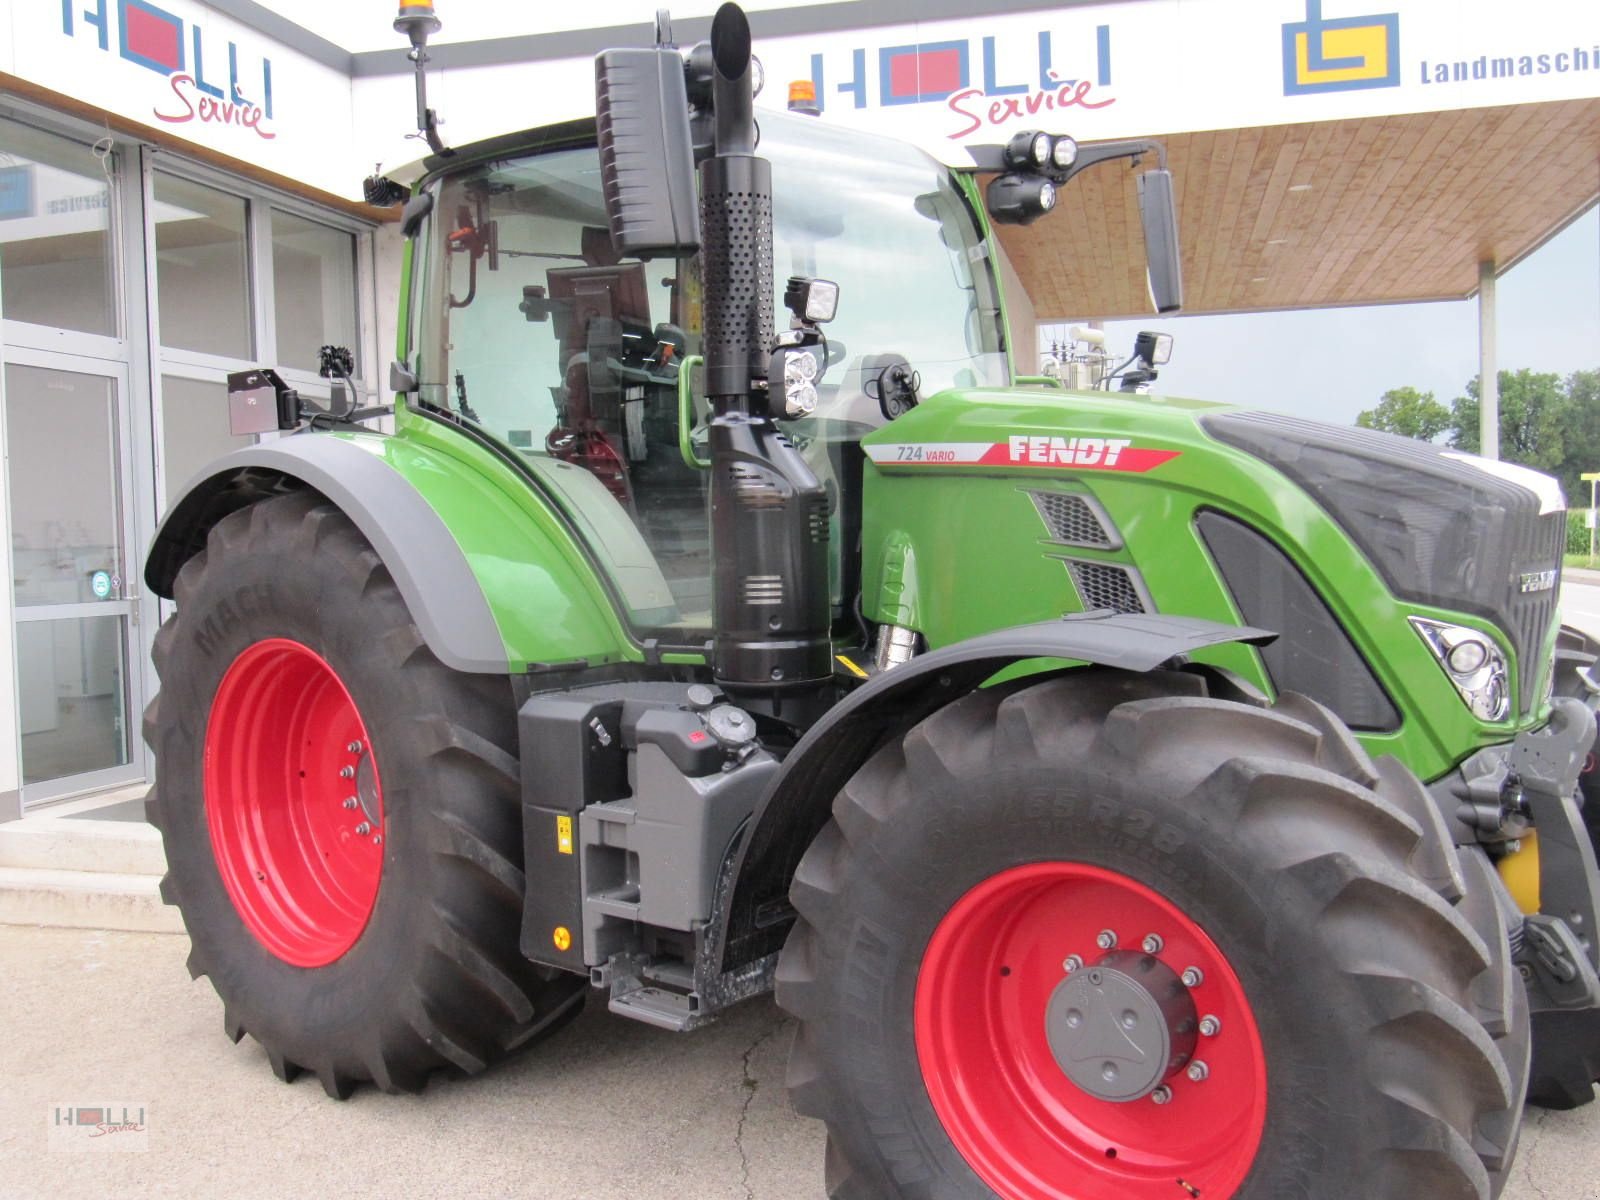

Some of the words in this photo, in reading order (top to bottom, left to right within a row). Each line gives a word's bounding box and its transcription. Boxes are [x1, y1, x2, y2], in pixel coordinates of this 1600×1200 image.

[811, 24, 1111, 112] HOLLI
[153, 75, 276, 139] Service
[946, 71, 1116, 139] Service
[897, 446, 923, 461] 724
[925, 450, 955, 462] VARIO
[1008, 435, 1132, 466] FENDT
